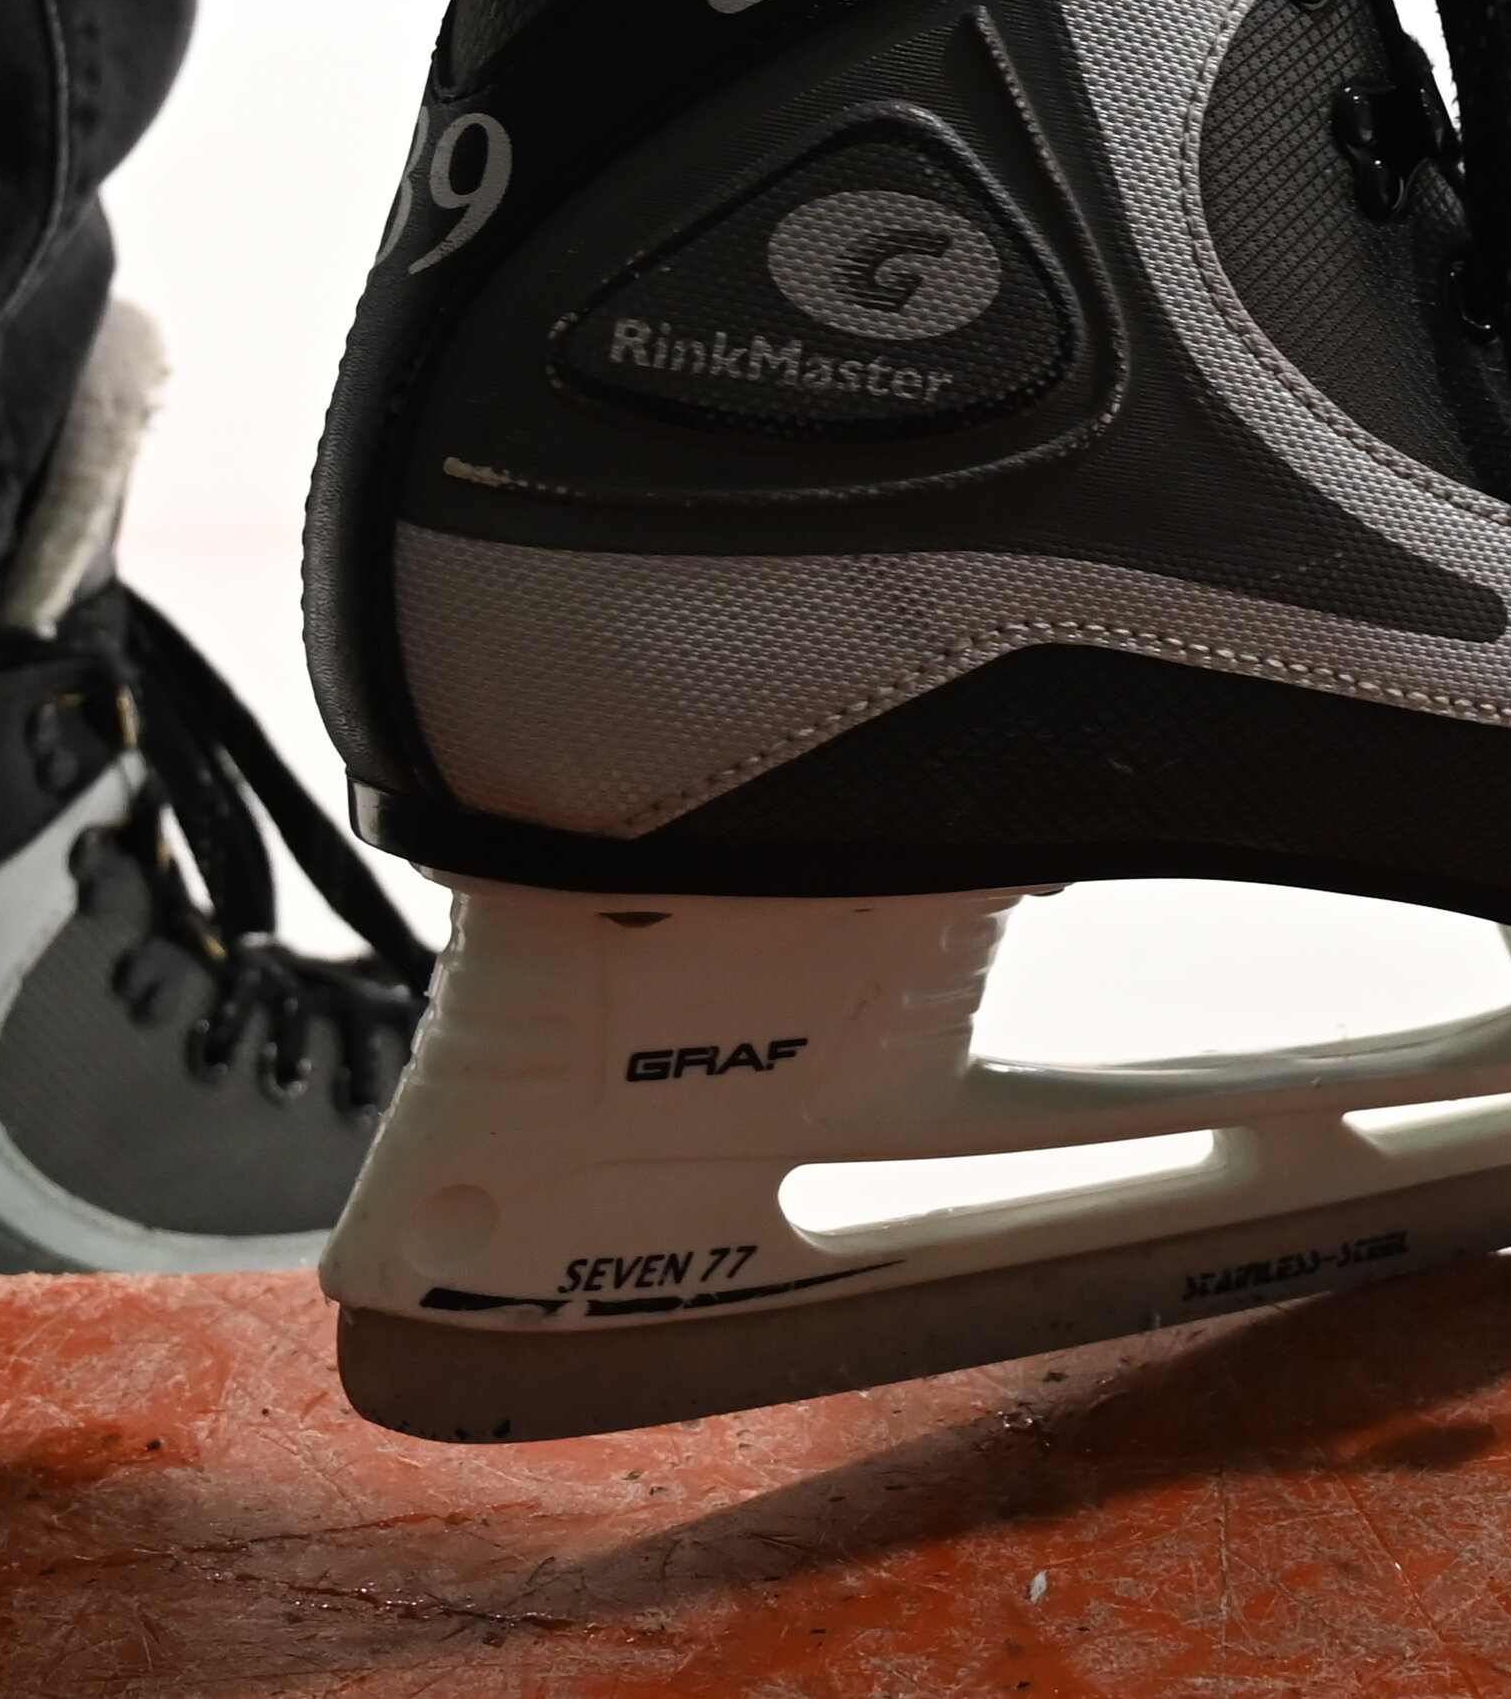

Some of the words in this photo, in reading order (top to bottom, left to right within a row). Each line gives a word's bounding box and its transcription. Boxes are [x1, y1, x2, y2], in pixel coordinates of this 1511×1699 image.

[609, 318, 954, 401] RinkMaster
[626, 1038, 808, 1082] GRAF
[557, 1251, 694, 1294] SEVEN
[699, 1245, 758, 1283] 77
